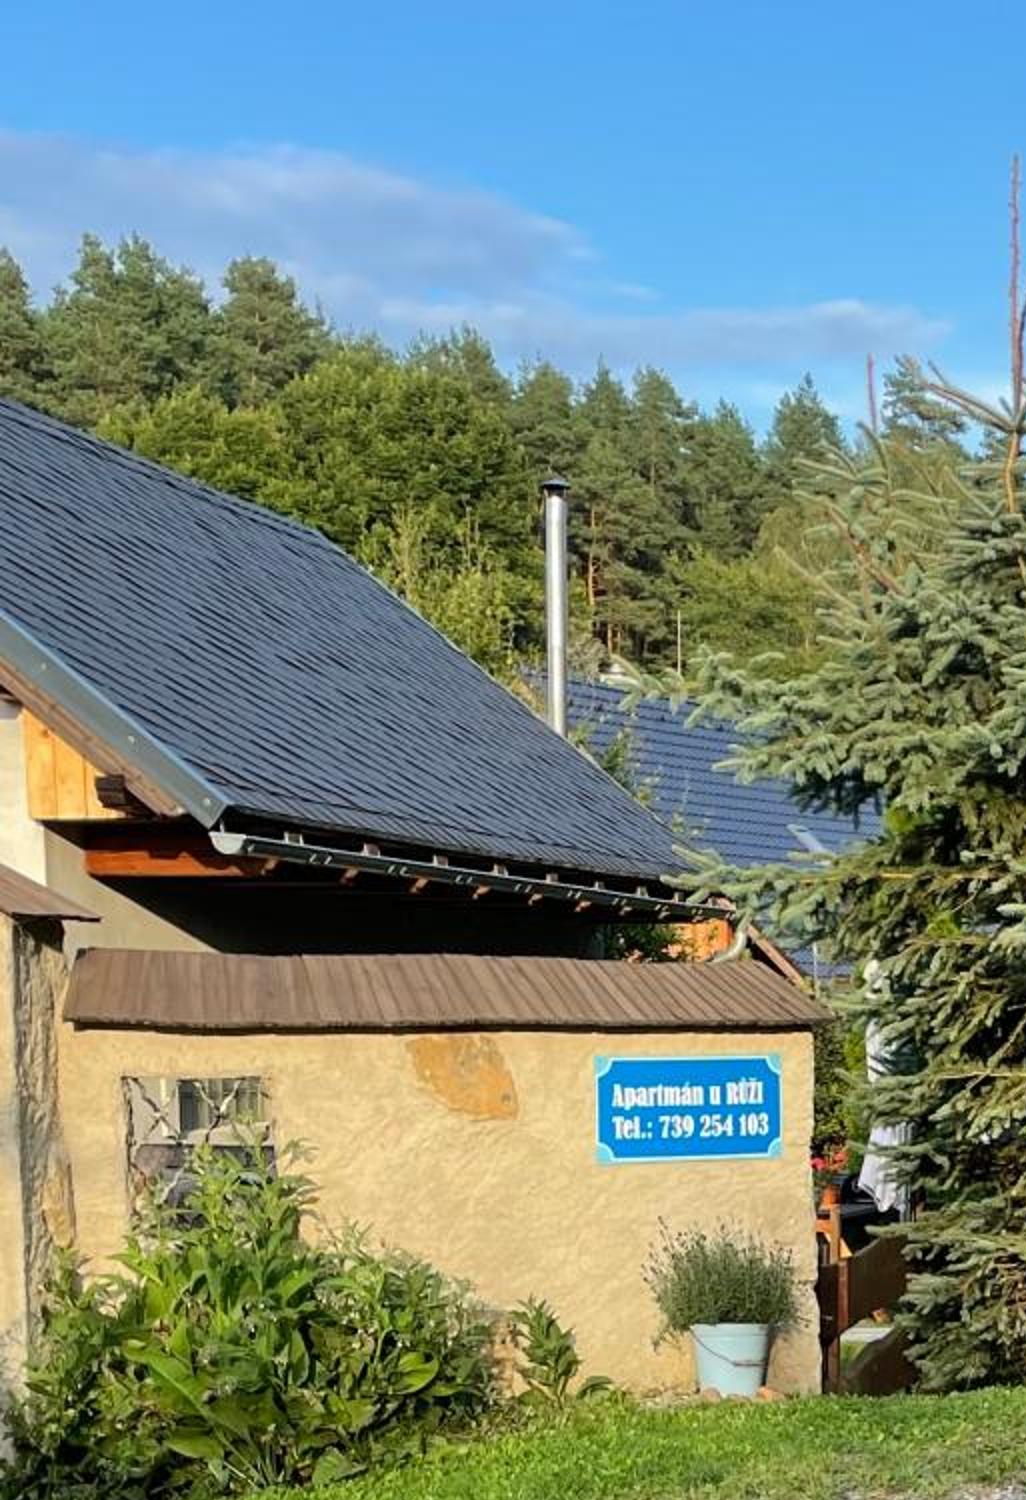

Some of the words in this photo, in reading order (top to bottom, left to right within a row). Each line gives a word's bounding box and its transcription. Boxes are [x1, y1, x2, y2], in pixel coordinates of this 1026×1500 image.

[612, 1081, 704, 1110] Apartmán
[709, 1085, 721, 1106] u
[612, 1115, 652, 1140] Tel.:
[658, 1115, 695, 1139] 739
[699, 1114, 733, 1137] 254
[739, 1113, 769, 1136] 103
